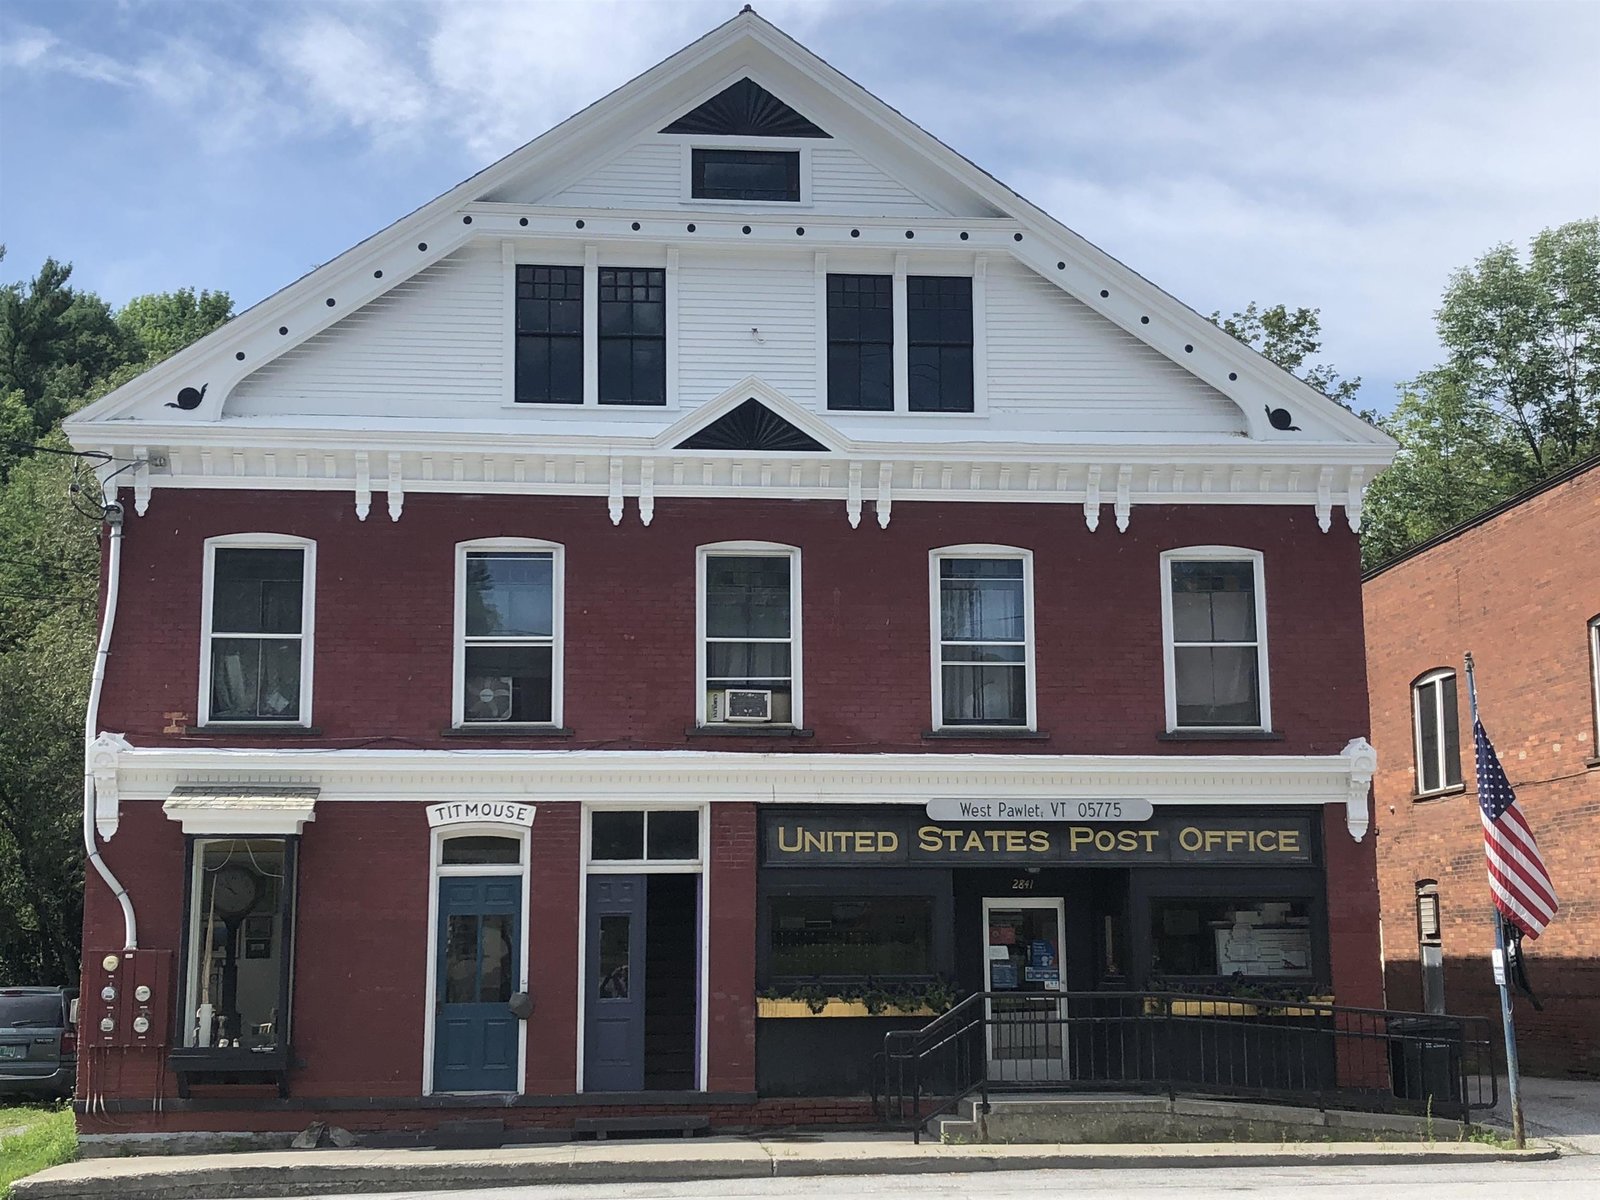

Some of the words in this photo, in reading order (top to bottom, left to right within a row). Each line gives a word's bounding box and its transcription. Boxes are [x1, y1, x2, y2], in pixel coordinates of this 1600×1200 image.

[435, 803, 528, 821] TITMOUSE
[960, 802, 992, 817] West
[1050, 802, 1066, 817] VT
[1077, 802, 1122, 818] 05775
[778, 826, 898, 853] UNITED
[918, 826, 1050, 852] STATES
[1069, 826, 1159, 852] POST
[1178, 826, 1300, 852] OFFICE
